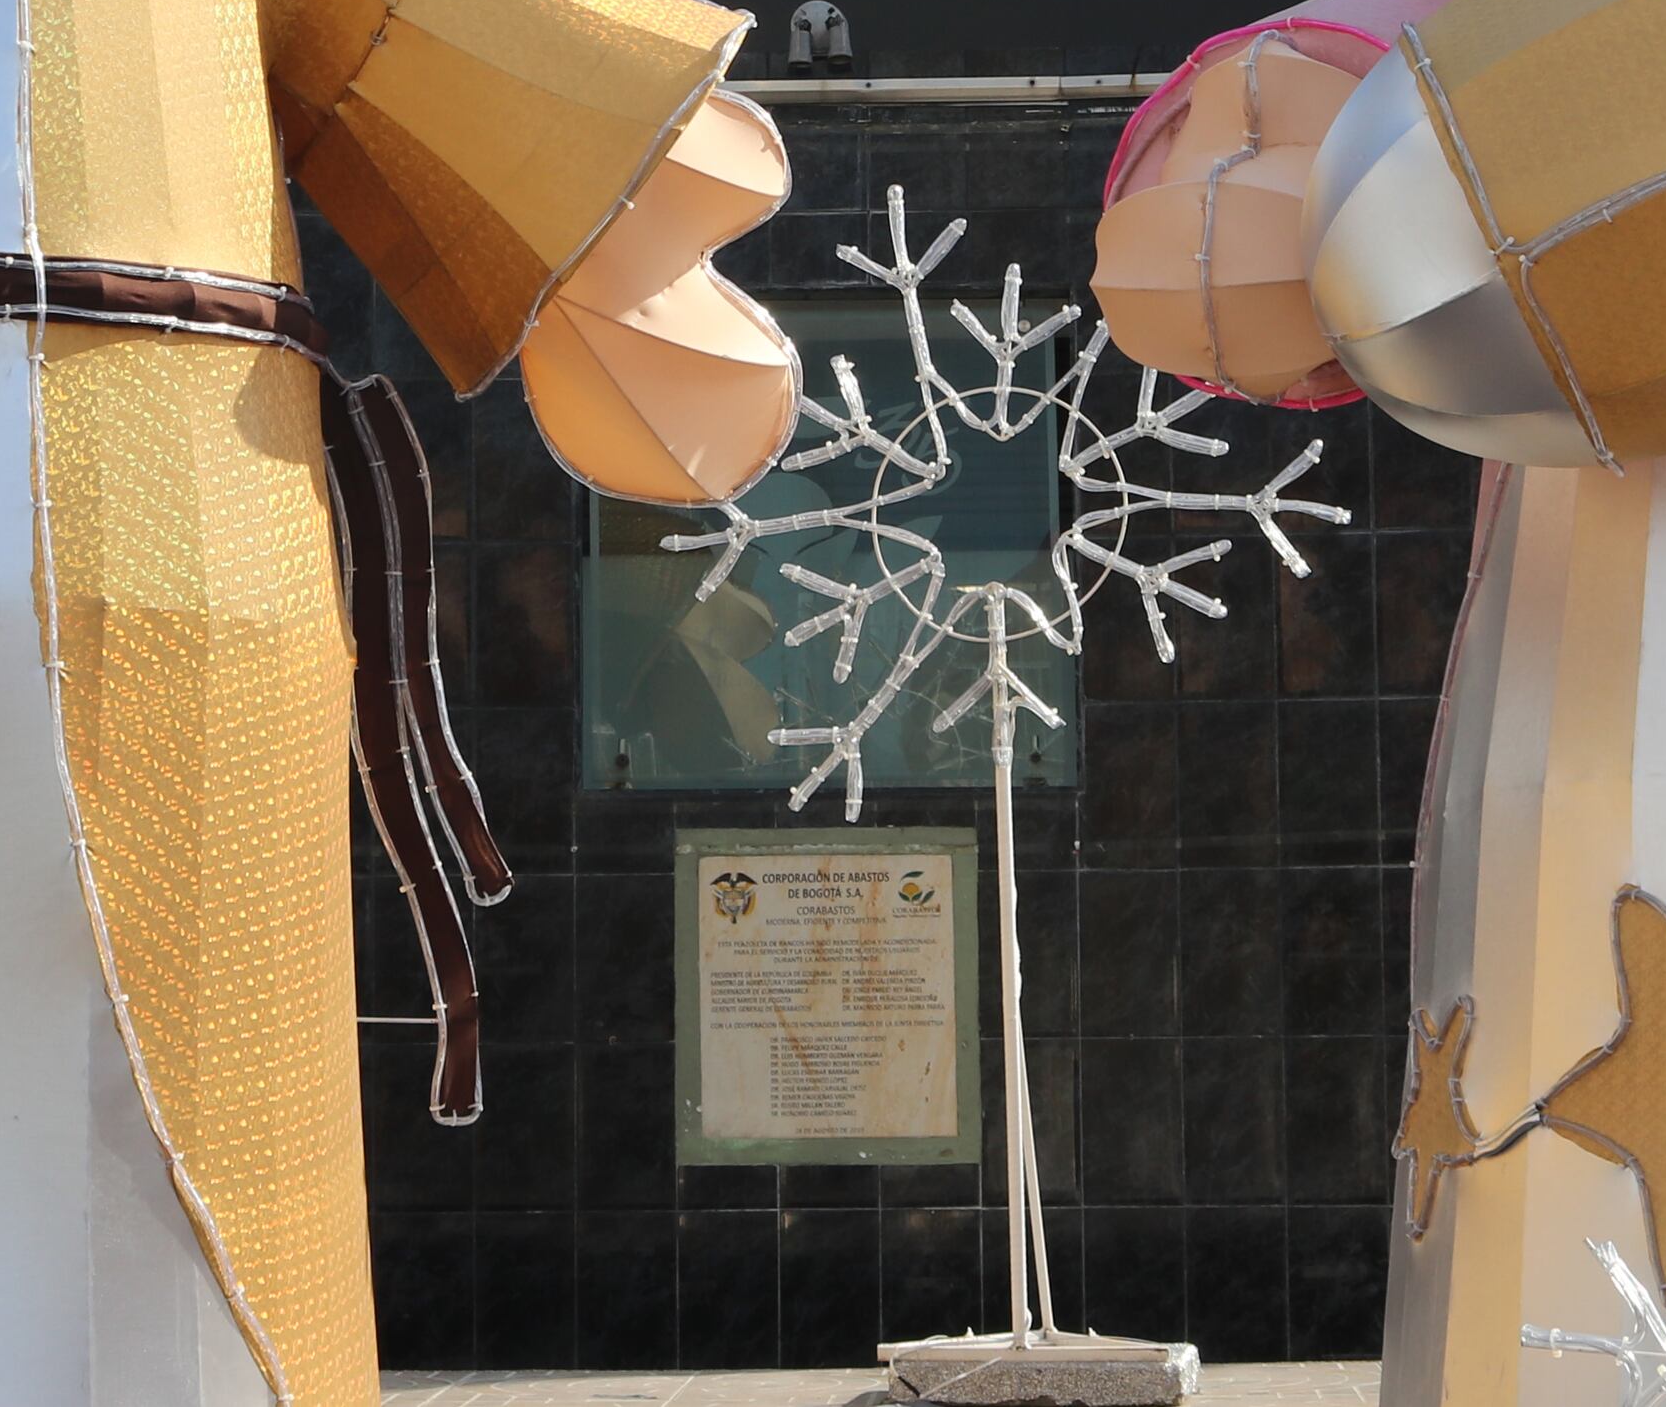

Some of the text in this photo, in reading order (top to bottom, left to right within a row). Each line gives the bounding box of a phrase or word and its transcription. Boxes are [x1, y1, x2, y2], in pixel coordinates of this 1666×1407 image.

[762, 872, 890, 884] CORPORACIÓN DE ABASTOS
[788, 888, 800, 899] DE
[803, 886, 841, 899] BOGOTÁ
[797, 906, 856, 916] CORABASTOS
